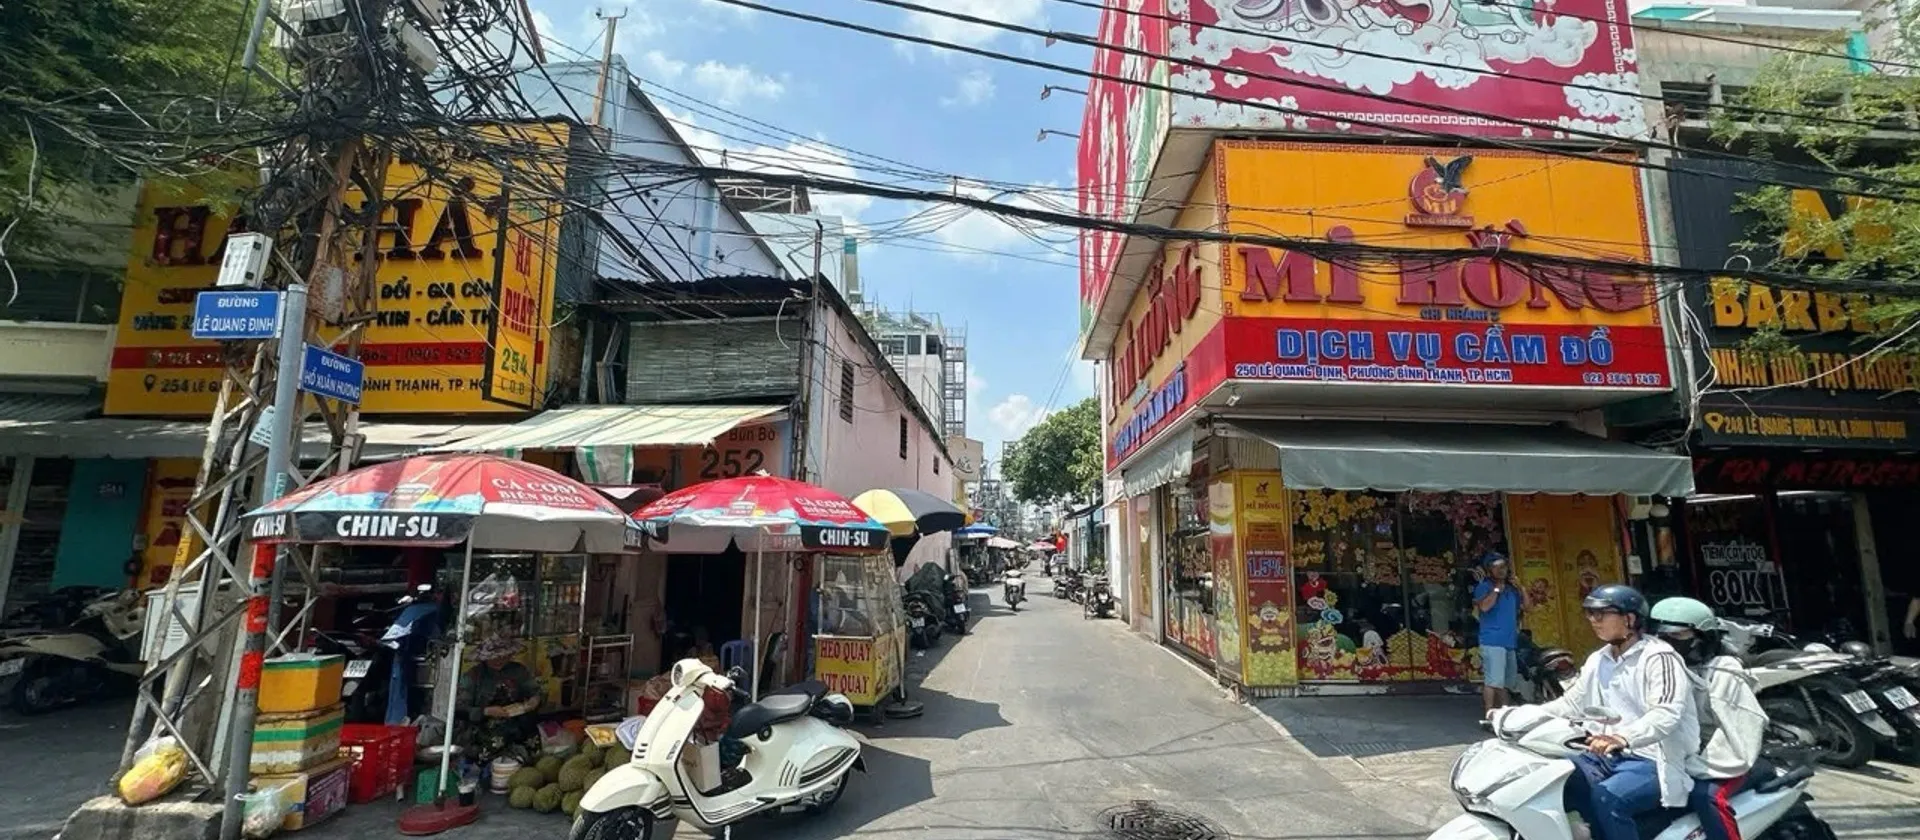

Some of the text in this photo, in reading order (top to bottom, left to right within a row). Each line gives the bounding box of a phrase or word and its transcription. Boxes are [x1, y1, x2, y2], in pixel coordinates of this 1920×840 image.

[428, 284, 455, 298] GIA
[218, 298, 259, 308] ĐƯỜNG
[197, 314, 210, 331] LÊ
[211, 318, 247, 332] QUANG
[248, 318, 274, 335] ĐỊNH
[377, 310, 409, 327] KIM
[1277, 324, 1613, 367] DỊCH VỤ CẦM ĐỒ
[321, 355, 351, 373] ĐƯỜNG
[501, 348, 527, 376] 254
[1235, 362, 1512, 384] 250 LÊ QUANG ĐỊNH, PHƯỜNG BÌNH THẠNH, TP. HCM
[161, 378, 189, 393] 254
[396, 379, 444, 395] THẠNH,
[702, 449, 765, 479] 252
[252, 514, 287, 537] CHIN-SU
[337, 515, 438, 538] CHIN-SU
[819, 529, 870, 547] CHIN-SU
[1710, 570, 1765, 605] 80K
[820, 640, 872, 664] HEO QUAY
[841, 675, 869, 695] QUAY
